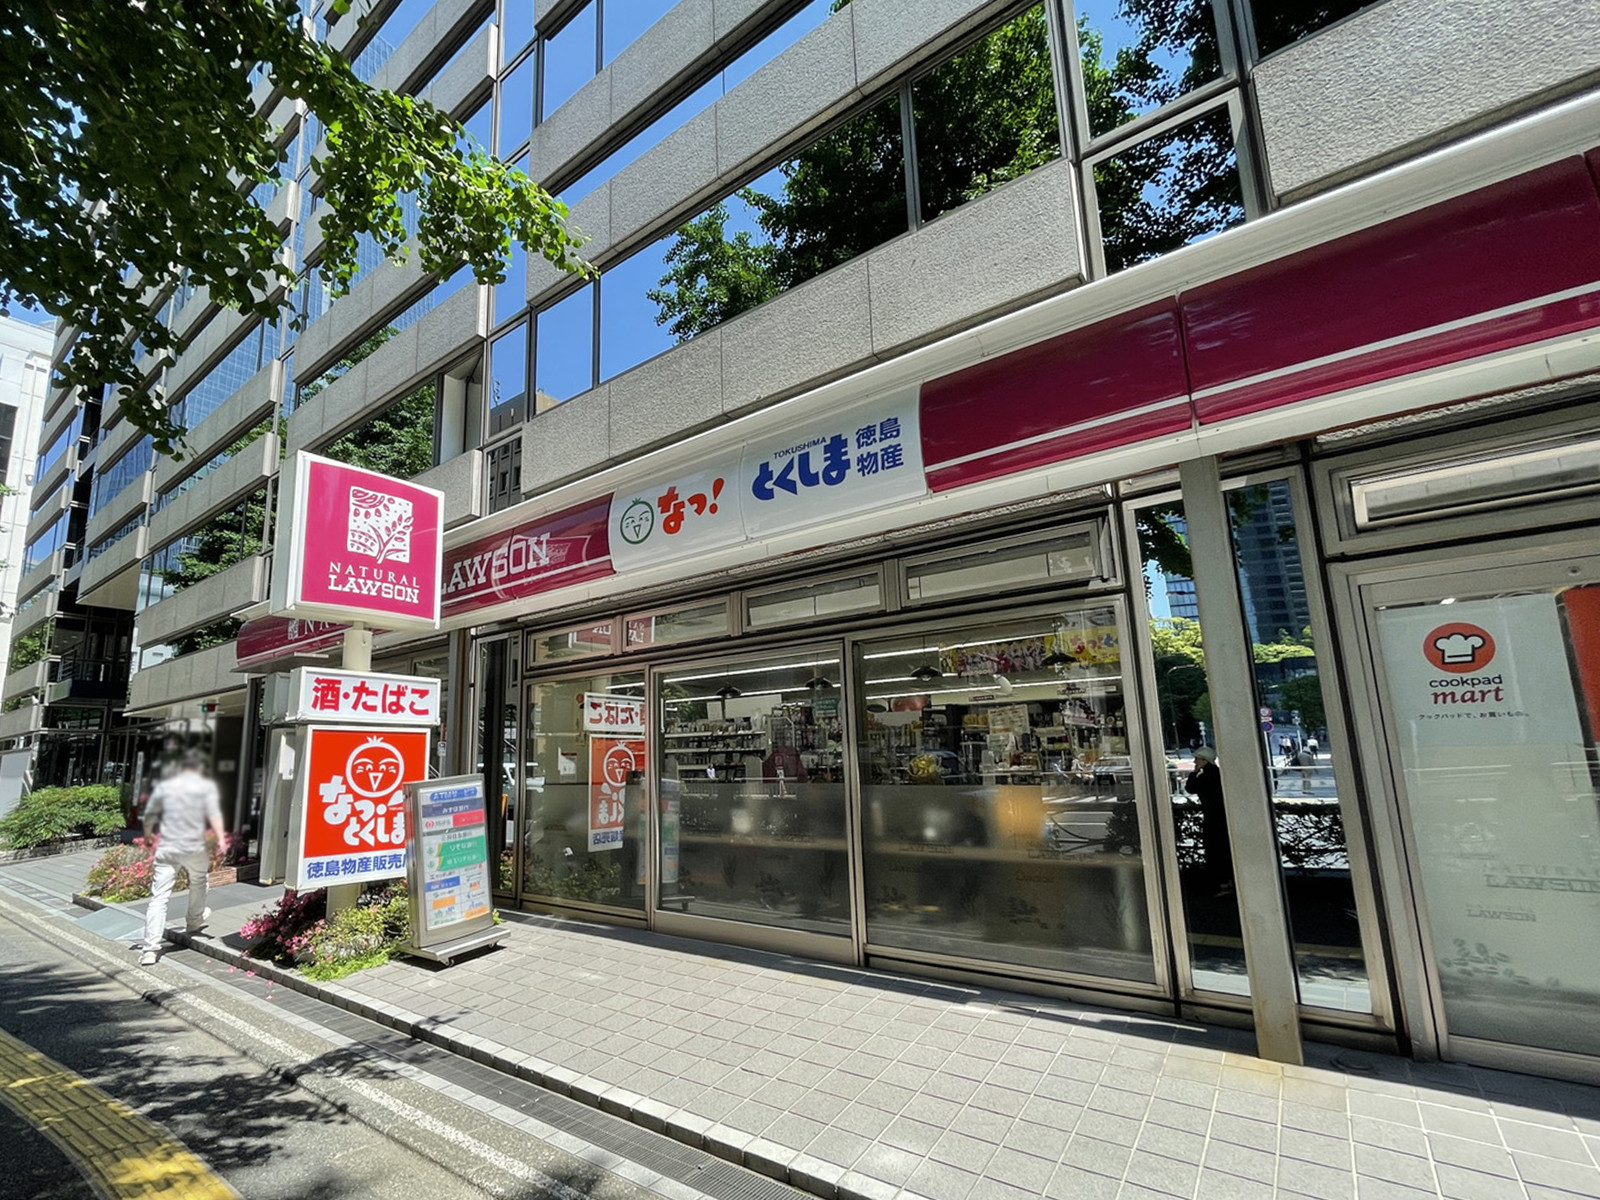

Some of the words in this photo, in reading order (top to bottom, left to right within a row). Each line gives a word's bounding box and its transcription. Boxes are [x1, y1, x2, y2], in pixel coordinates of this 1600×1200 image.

[856, 417, 901, 449] 徳島
[774, 437, 827, 459] TOKUSHIMA
[857, 443, 904, 477] 物産
[752, 433, 851, 500] とくしま
[329, 561, 420, 588] NATURAL
[328, 574, 420, 604] LAWSON
[1429, 674, 1504, 689] cookpad
[1431, 686, 1505, 704] mart
[307, 853, 405, 879] 徳島物産販売
